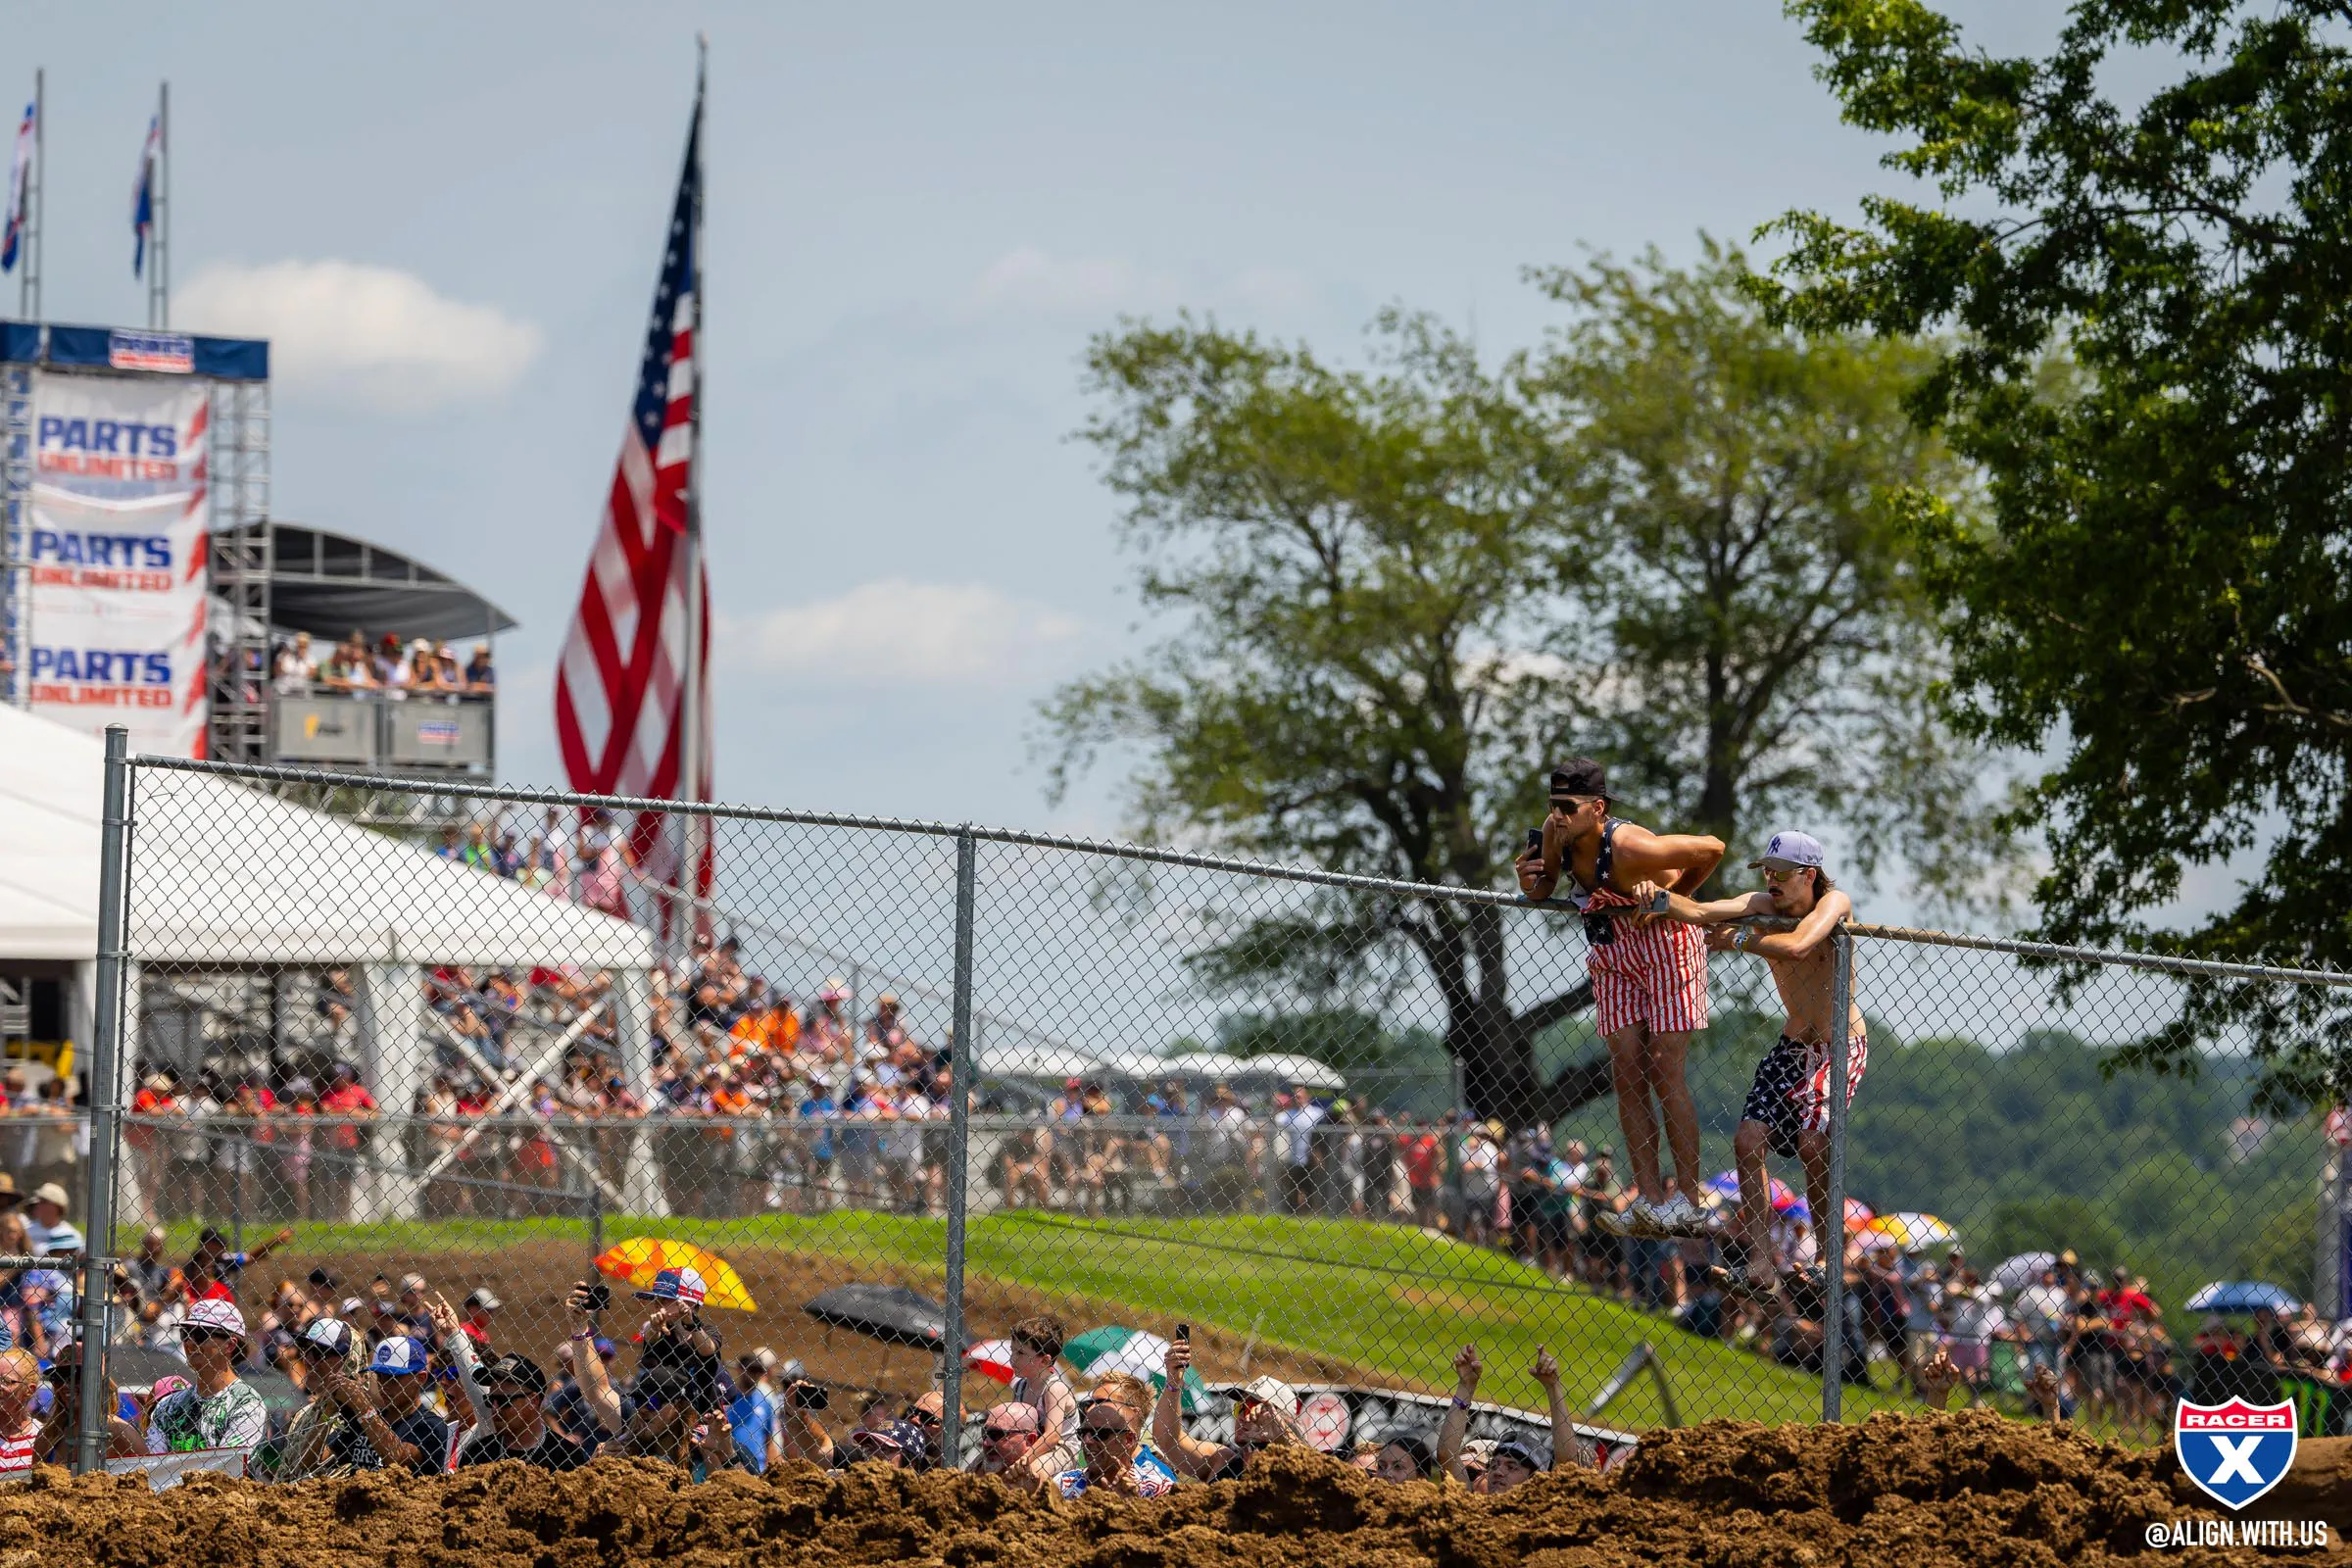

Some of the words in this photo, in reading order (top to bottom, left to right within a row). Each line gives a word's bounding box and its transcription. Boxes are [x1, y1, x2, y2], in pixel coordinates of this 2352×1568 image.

[38, 416, 177, 458] PARTS
[31, 530, 172, 567] PARTS
[31, 648, 172, 683] PARTS
[31, 685, 173, 708] UNLIMITED
